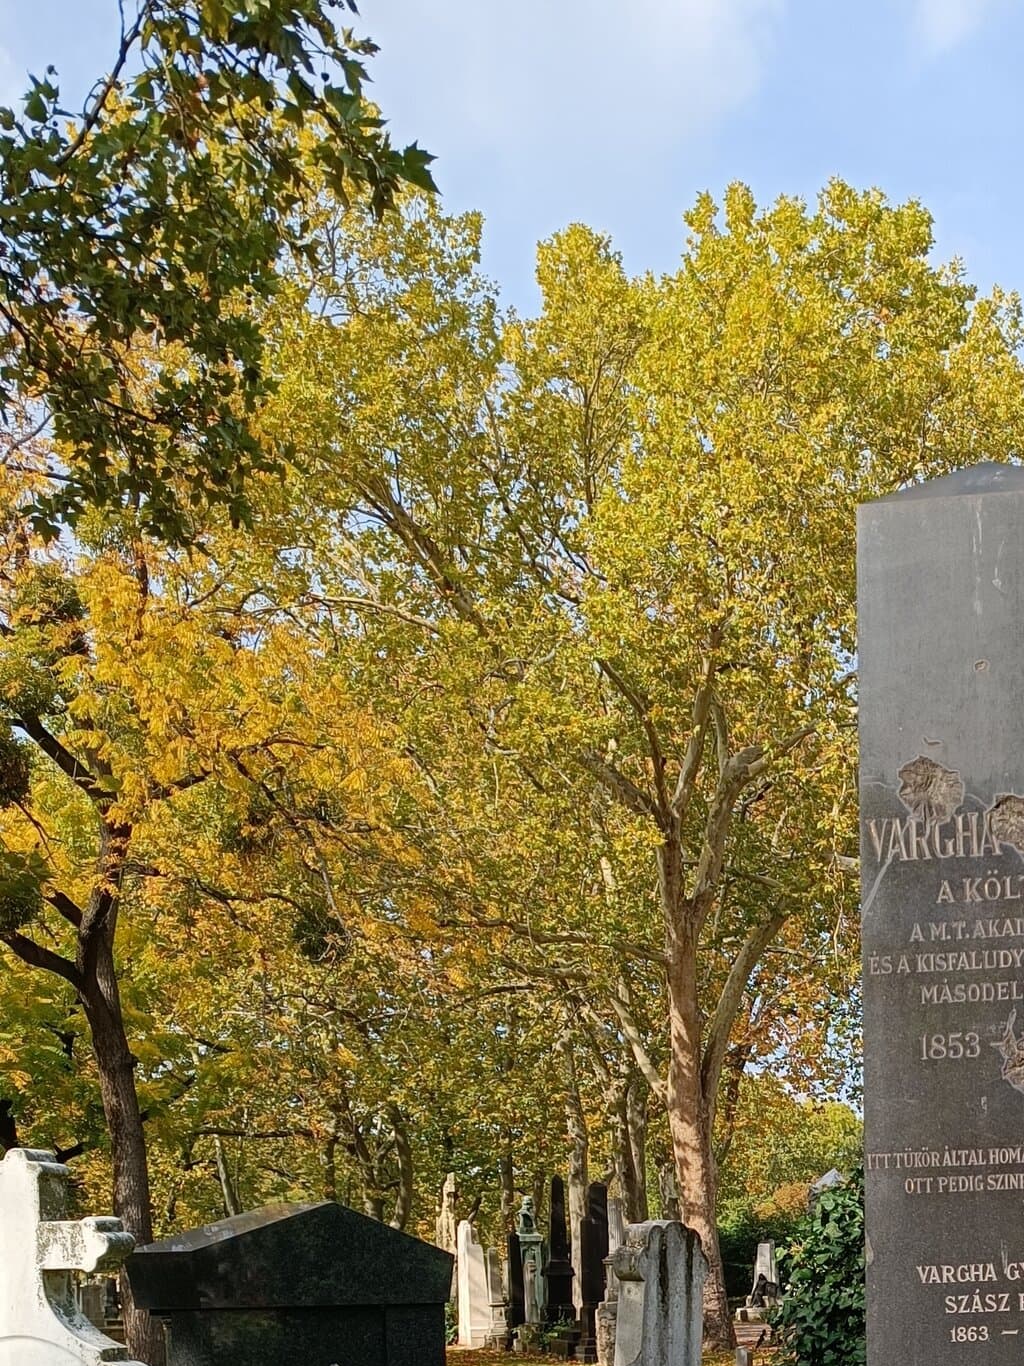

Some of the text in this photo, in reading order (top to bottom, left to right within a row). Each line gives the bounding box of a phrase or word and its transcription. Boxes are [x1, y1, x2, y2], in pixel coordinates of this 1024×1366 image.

[936, 879, 955, 904] A
[909, 922, 925, 942] A
[868, 951, 893, 975] ÉS
[896, 956, 911, 974] A
[920, 1032, 981, 1060] 1853
[867, 1153, 891, 1169] ITT
[894, 1146, 940, 1169] TÜKÖR
[943, 1145, 986, 1166] ÁLTAL
[905, 1177, 933, 1194] OTT
[937, 1175, 984, 1193] PEDIG
[916, 1263, 998, 1284] VARGHA
[945, 1288, 1010, 1314] SZÁSZ
[950, 1325, 989, 1343] 1863
